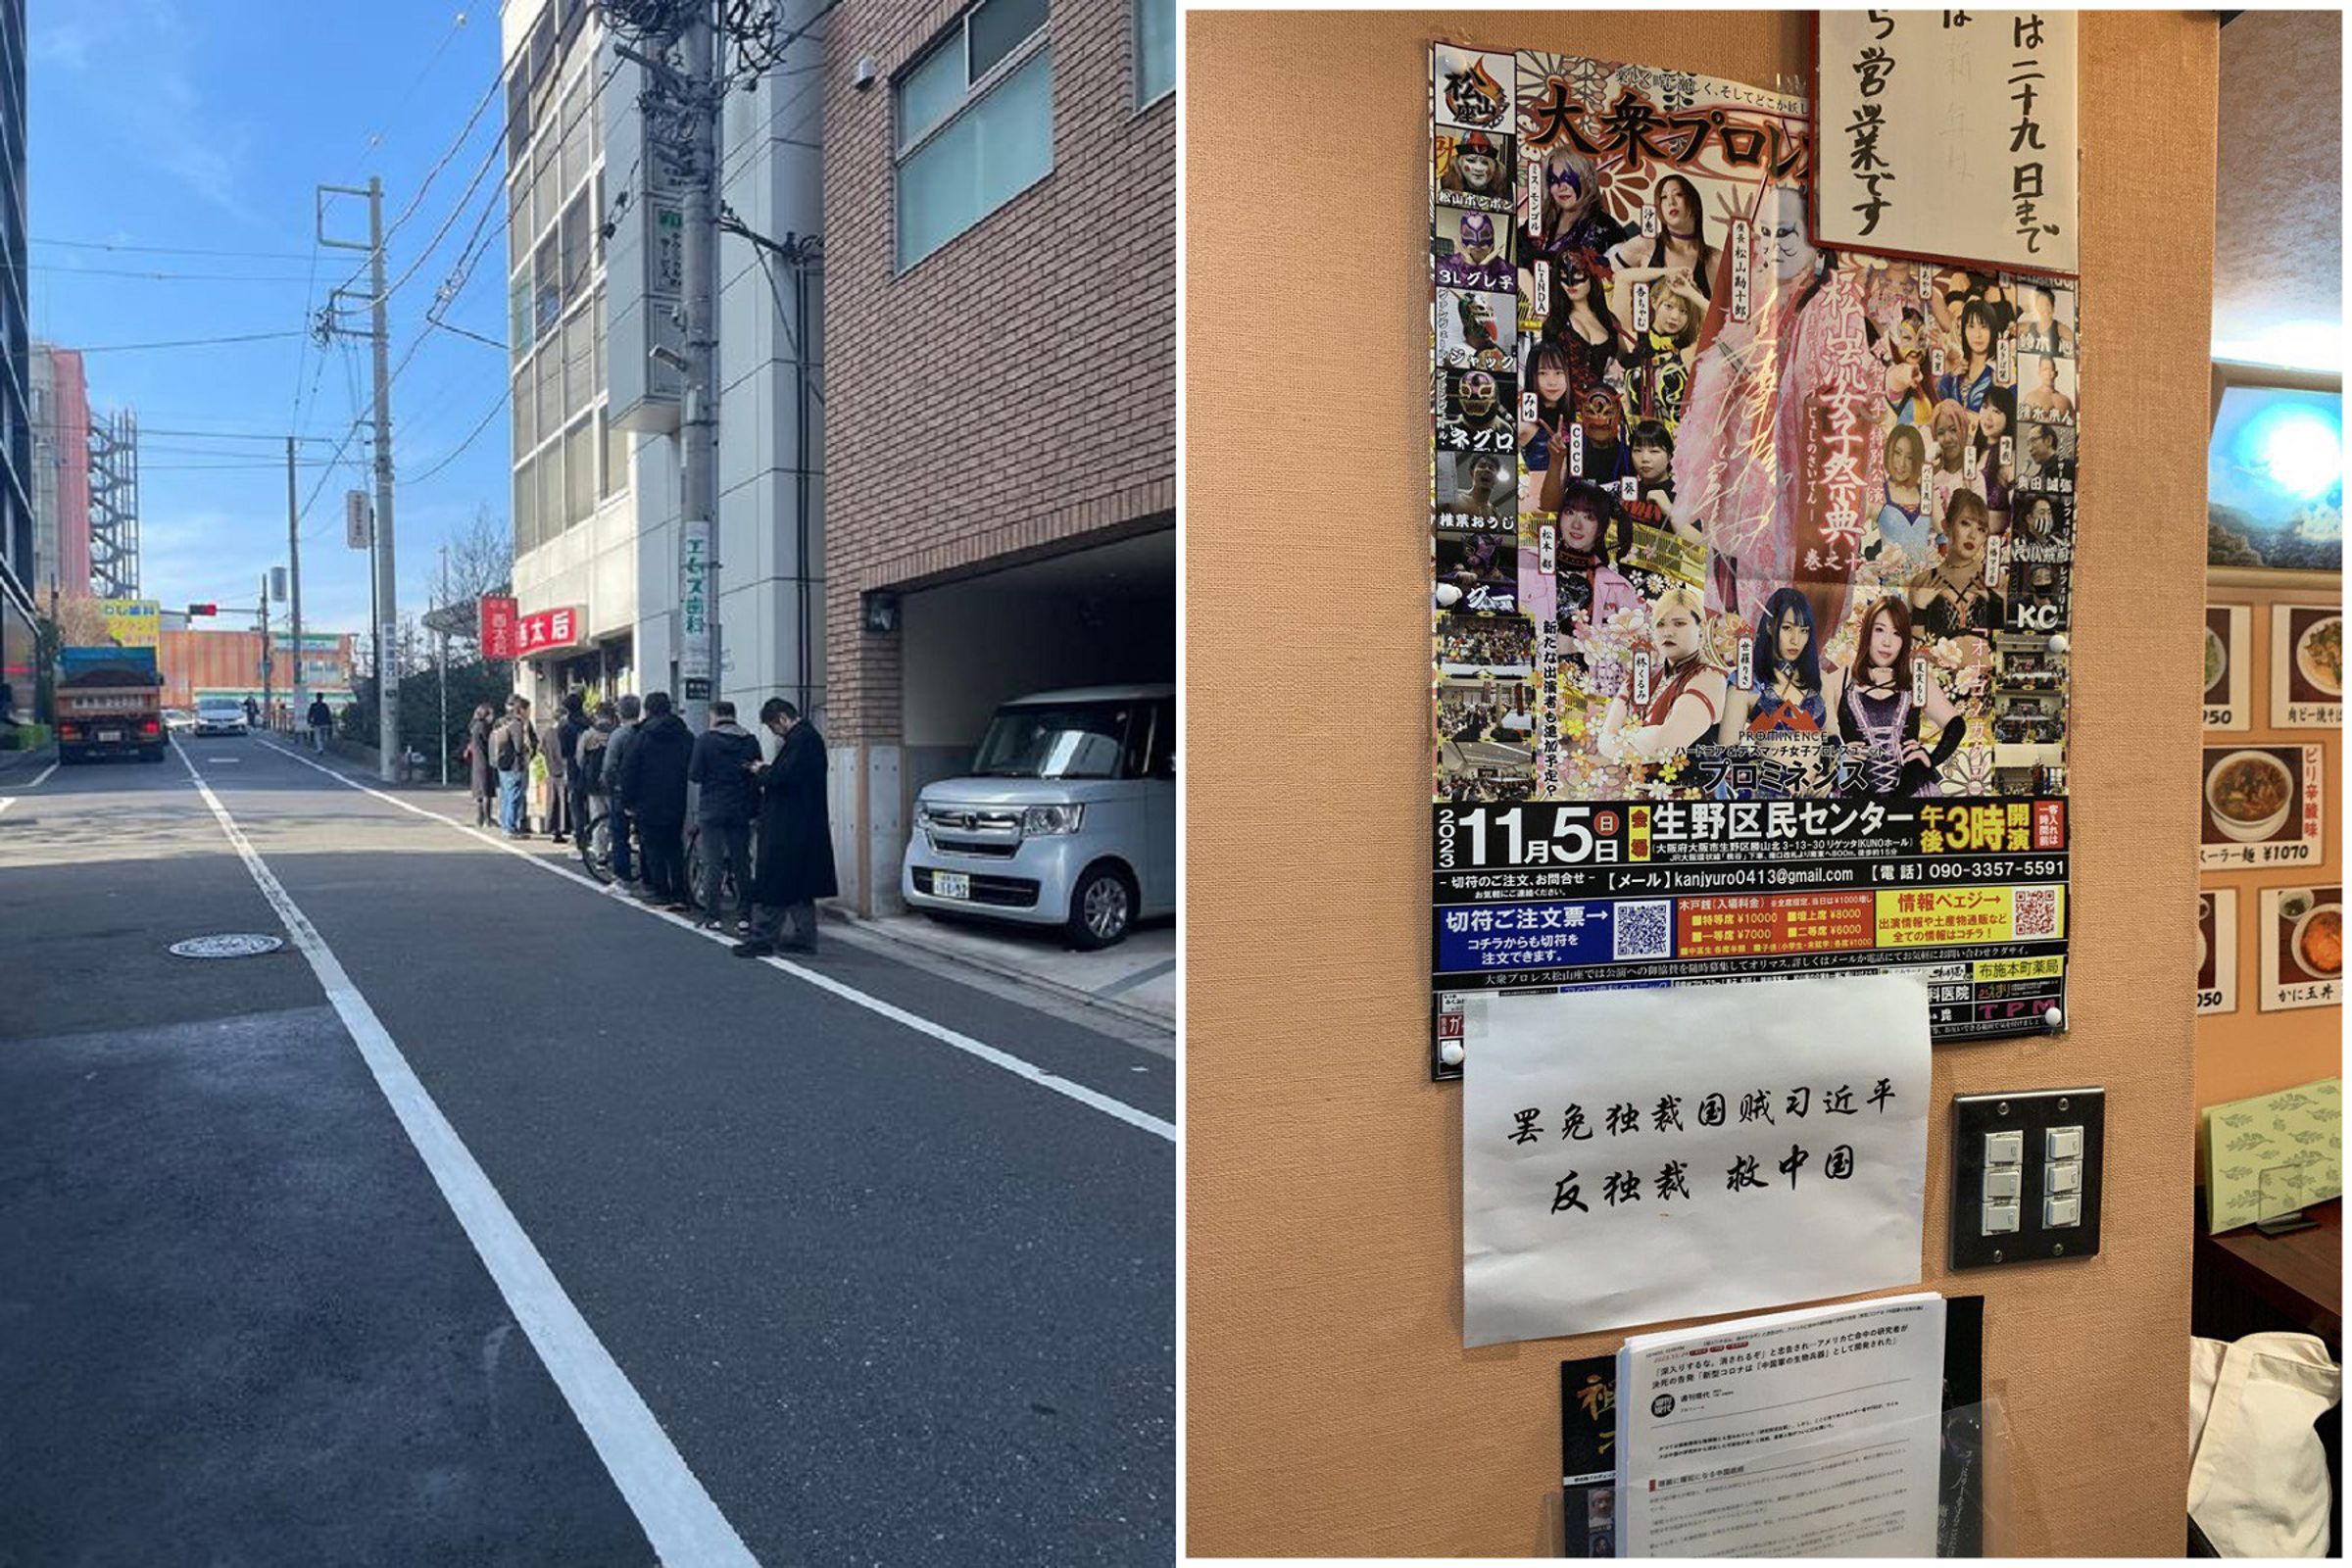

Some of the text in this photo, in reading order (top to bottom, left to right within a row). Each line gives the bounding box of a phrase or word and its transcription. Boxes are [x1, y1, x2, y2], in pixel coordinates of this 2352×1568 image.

[1528, 81, 1809, 180] 大衆プロレ
[2008, 14, 2060, 254] は二十九日まで
[1538, 263, 1547, 312] LINDA
[1524, 394, 1536, 417] みゆ
[1449, 424, 1514, 451] ネグロ
[2018, 603, 2059, 629] KC
[1739, 730, 1828, 742] PROMINENCE
[1699, 758, 1869, 794] プロミネンス
[1652, 801, 1915, 840] 生野区民センター
[1920, 805, 1945, 854] 午後
[1945, 804, 2006, 852] 3時
[2007, 803, 2031, 851] 開演
[1439, 809, 1455, 868] 2023
[2263, 845, 2309, 861] ¥1070
[1674, 866, 1854, 889] kanjyuro0413@gmail.com
[1929, 860, 2064, 879] 090-3357-5591
[1446, 905, 1586, 933] 切符ご注文票
[1468, 933, 1579, 951] コチラからも切符を
[1482, 950, 1563, 966] 注文できます。
[1979, 958, 2059, 979] 布施本町薬局
[2278, 983, 2333, 1003] かに玉丼
[1550, 1144, 1856, 1215] 反独裁 救中国
